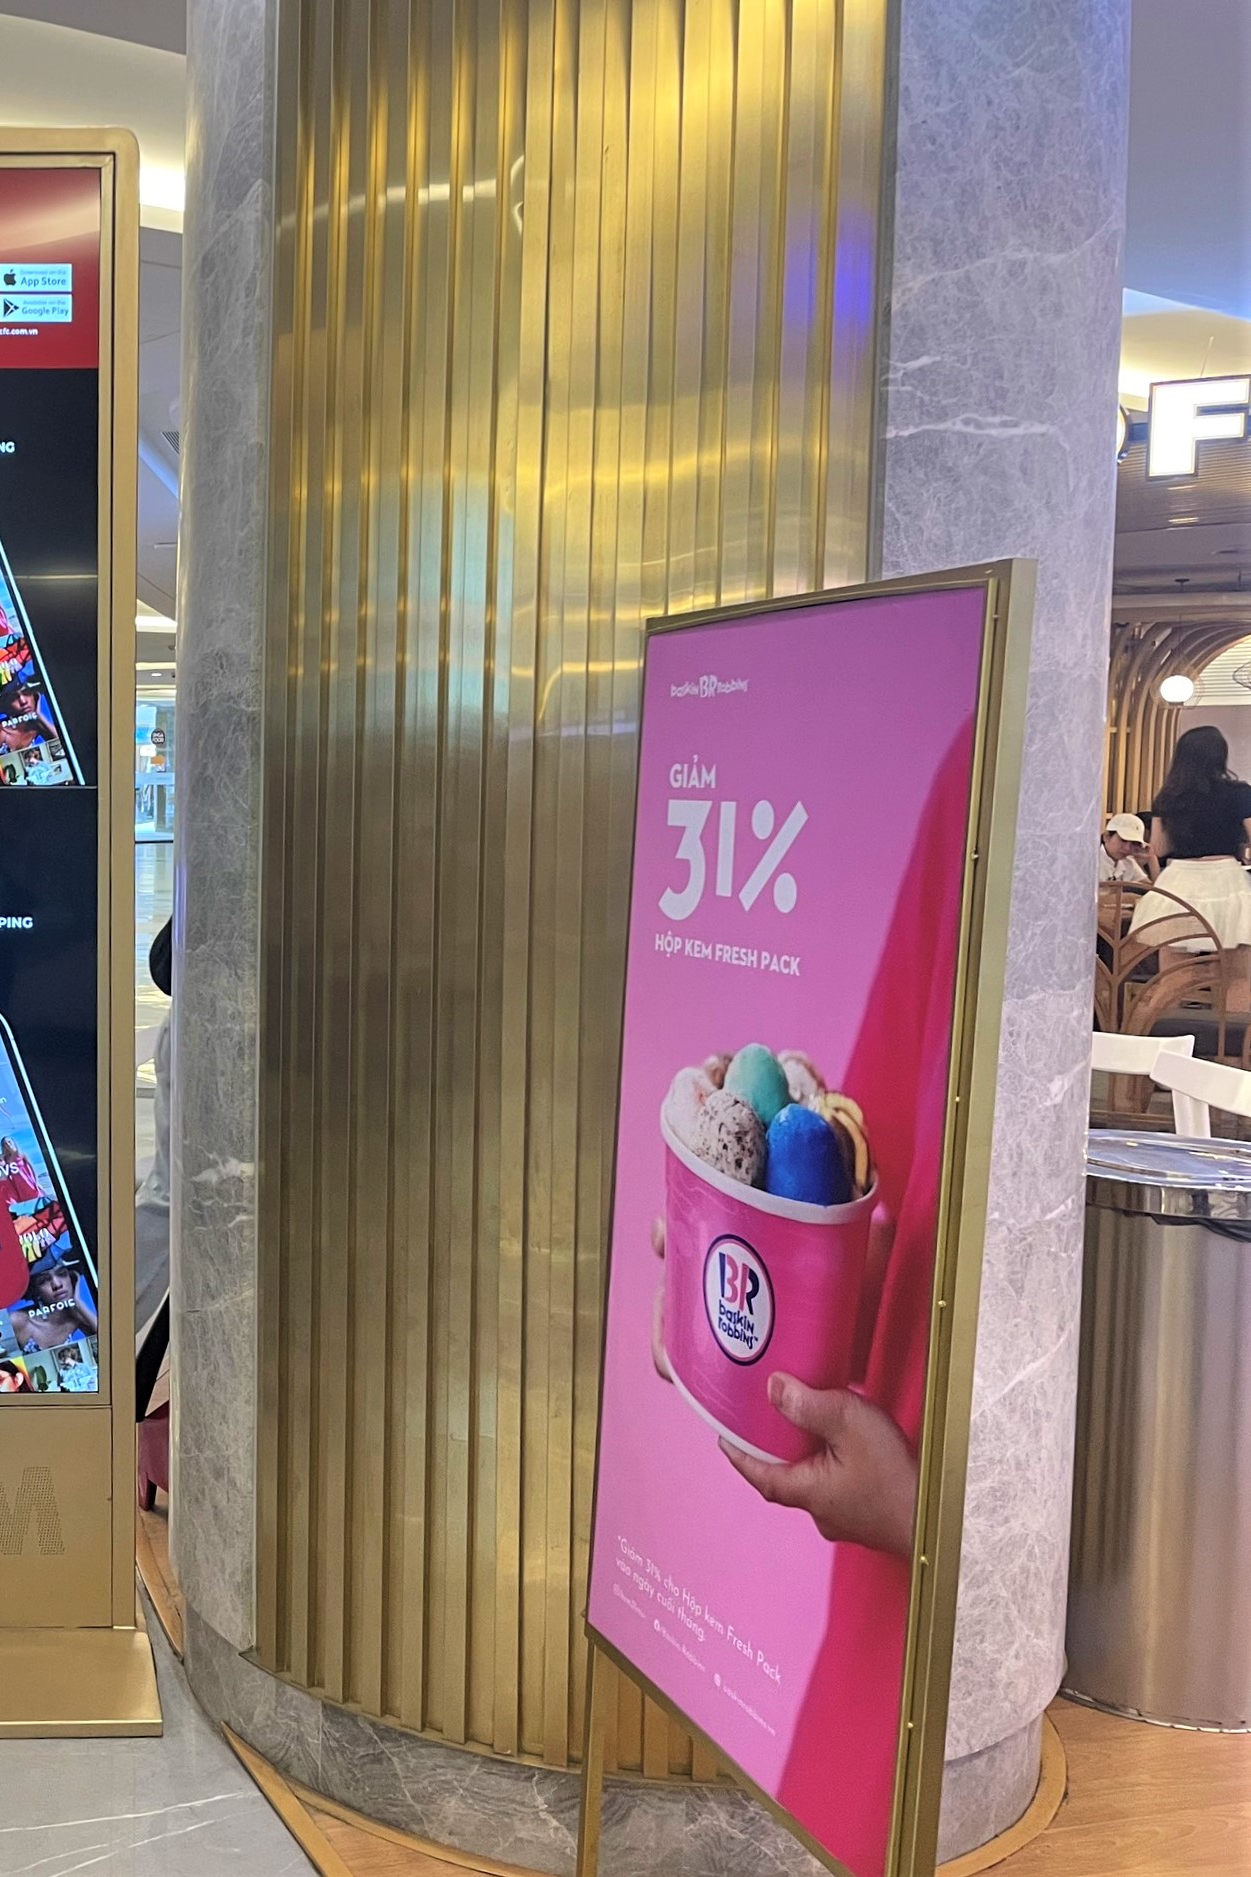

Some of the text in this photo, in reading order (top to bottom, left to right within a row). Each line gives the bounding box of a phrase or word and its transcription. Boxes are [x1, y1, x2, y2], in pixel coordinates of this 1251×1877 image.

[20, 277, 67, 287] App Store
[21, 306, 69, 317] Google Play
[1149, 375, 1250, 478] F
[699, 674, 717, 698] BR
[669, 755, 716, 788] GIẢM
[657, 799, 809, 921] 31%
[654, 930, 800, 977] HỘP KEM FRESH PACK
[718, 1252, 760, 1316] BR
[718, 1299, 755, 1334] baskin
[645, 1558, 661, 1582] 31%
[664, 1576, 680, 1597] cho
[704, 1605, 724, 1635] kem
[727, 1625, 753, 1660] Fresh
[756, 1650, 781, 1685] Pack
